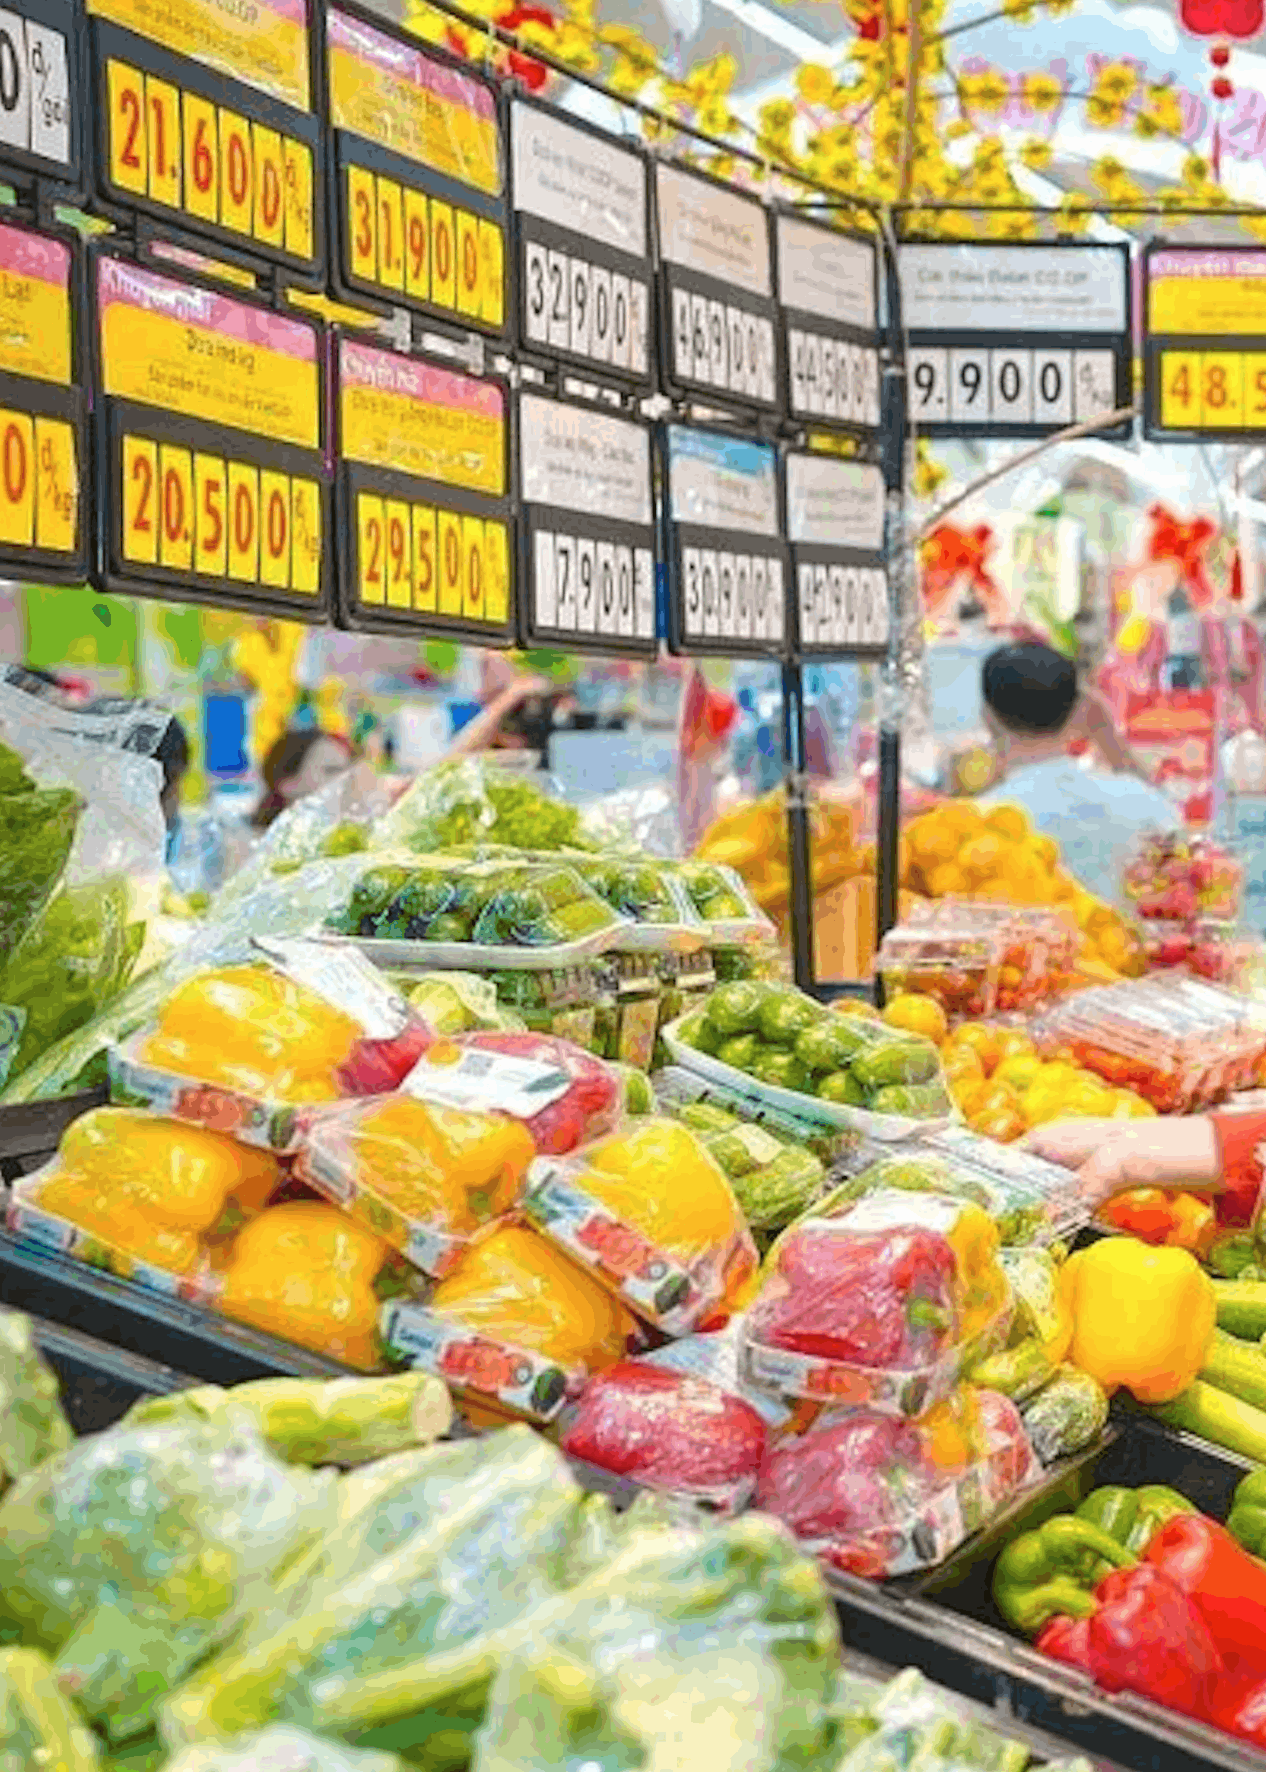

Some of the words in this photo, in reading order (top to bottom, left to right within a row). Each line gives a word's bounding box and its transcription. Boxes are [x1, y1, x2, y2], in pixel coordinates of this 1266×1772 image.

[121, 87, 281, 229] 21.600
[355, 190, 478, 293] 31.900
[914, 361, 1062, 408] 9.900
[131, 455, 287, 560] 20.500
[366, 517, 482, 604] 29.500
[558, 547, 630, 616] 7.900
